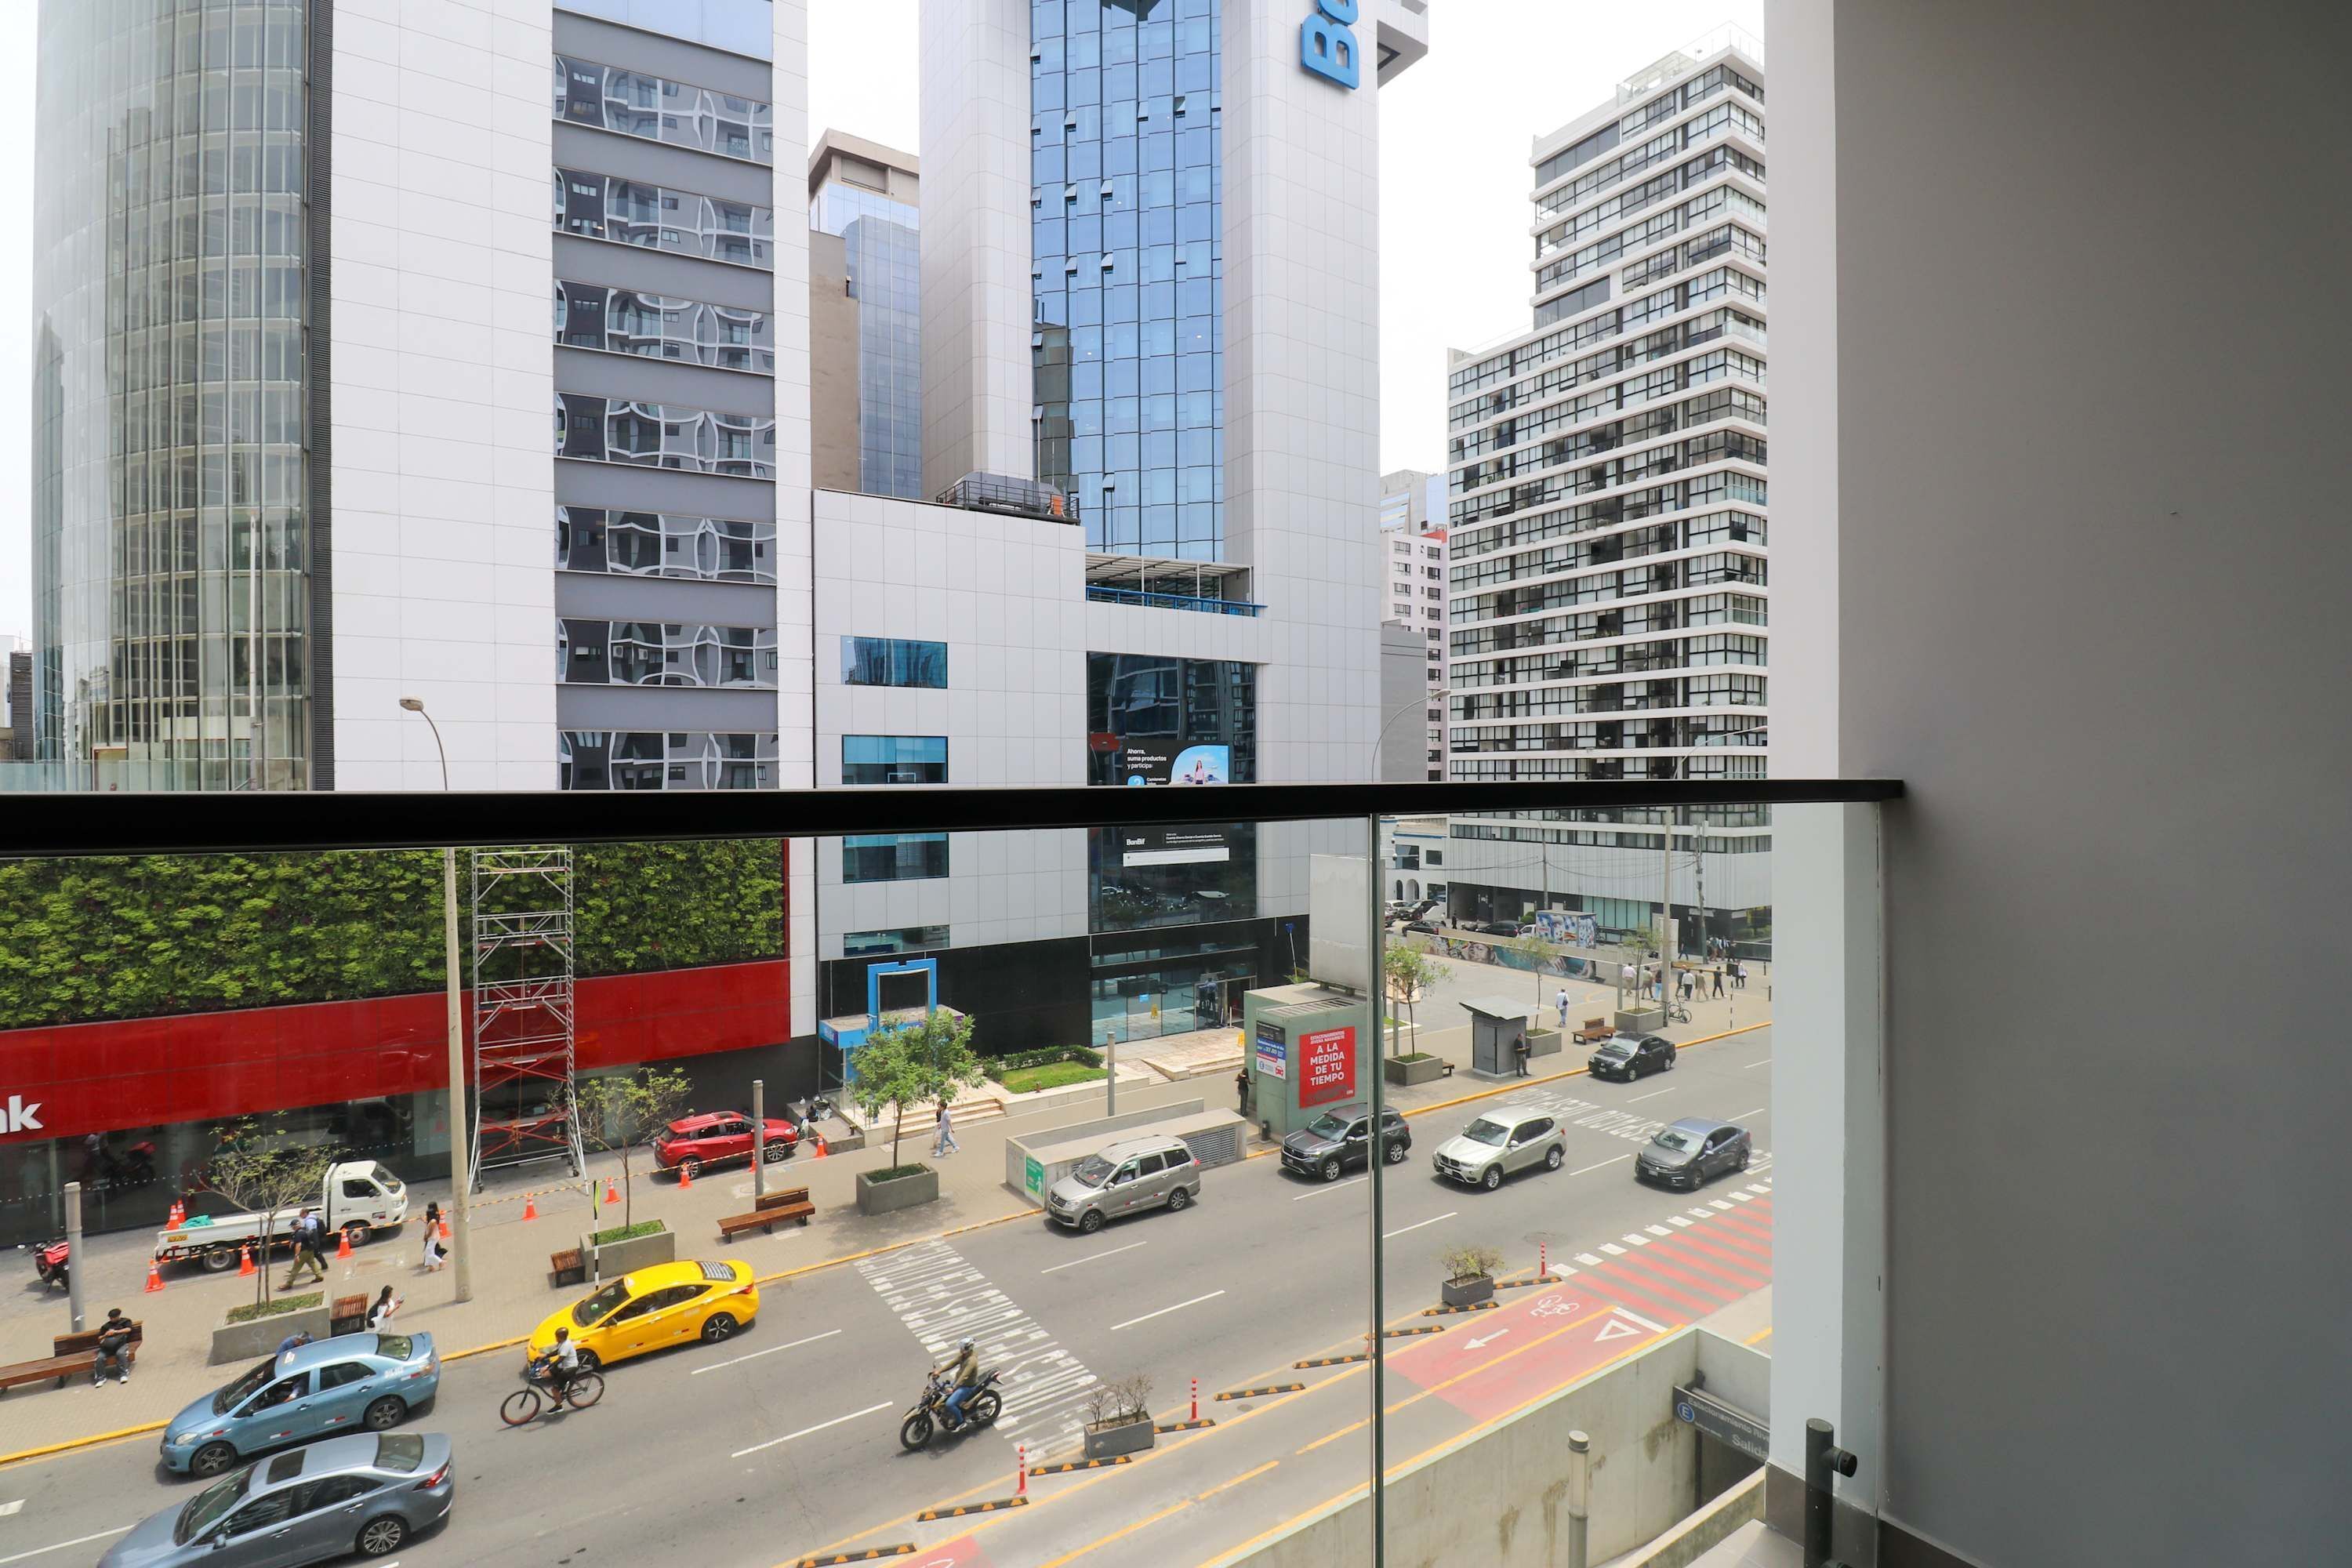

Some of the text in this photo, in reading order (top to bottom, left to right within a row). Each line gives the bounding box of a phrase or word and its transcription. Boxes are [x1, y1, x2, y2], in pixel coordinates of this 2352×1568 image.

[1316, 1042, 1338, 1054] A LA
[1310, 1052, 1345, 1065] MEDIDA
[1316, 1062, 1342, 1075] DE TU
[1310, 1072, 1345, 1086] TIEMPO
[1687, 1397, 1752, 1434] Estacionamiento
